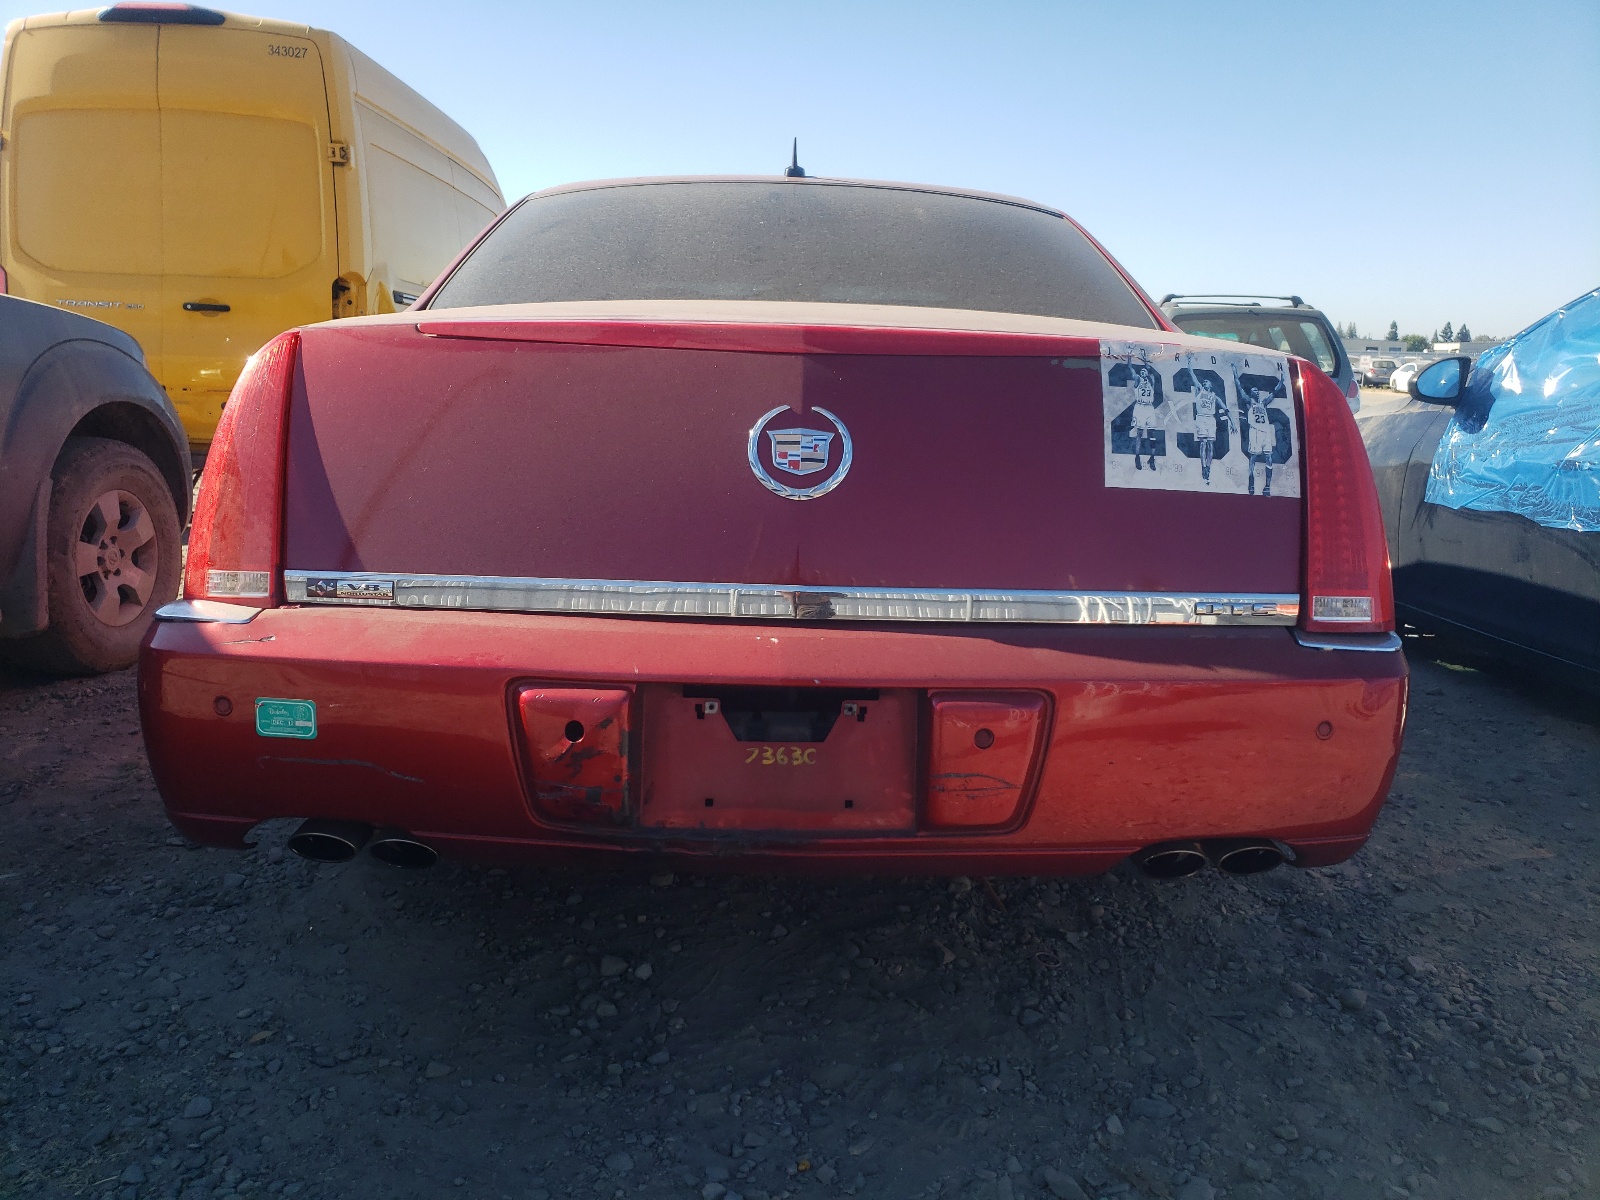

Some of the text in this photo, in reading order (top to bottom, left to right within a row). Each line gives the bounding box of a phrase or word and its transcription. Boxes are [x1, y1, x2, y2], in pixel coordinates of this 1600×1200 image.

[268, 45, 308, 58] 343027
[56, 299, 123, 309] TRANSIT
[1141, 388, 1152, 397] 23
[1254, 414, 1267, 424] 23
[343, 583, 380, 592] V8
[744, 746, 817, 766] 7363C
